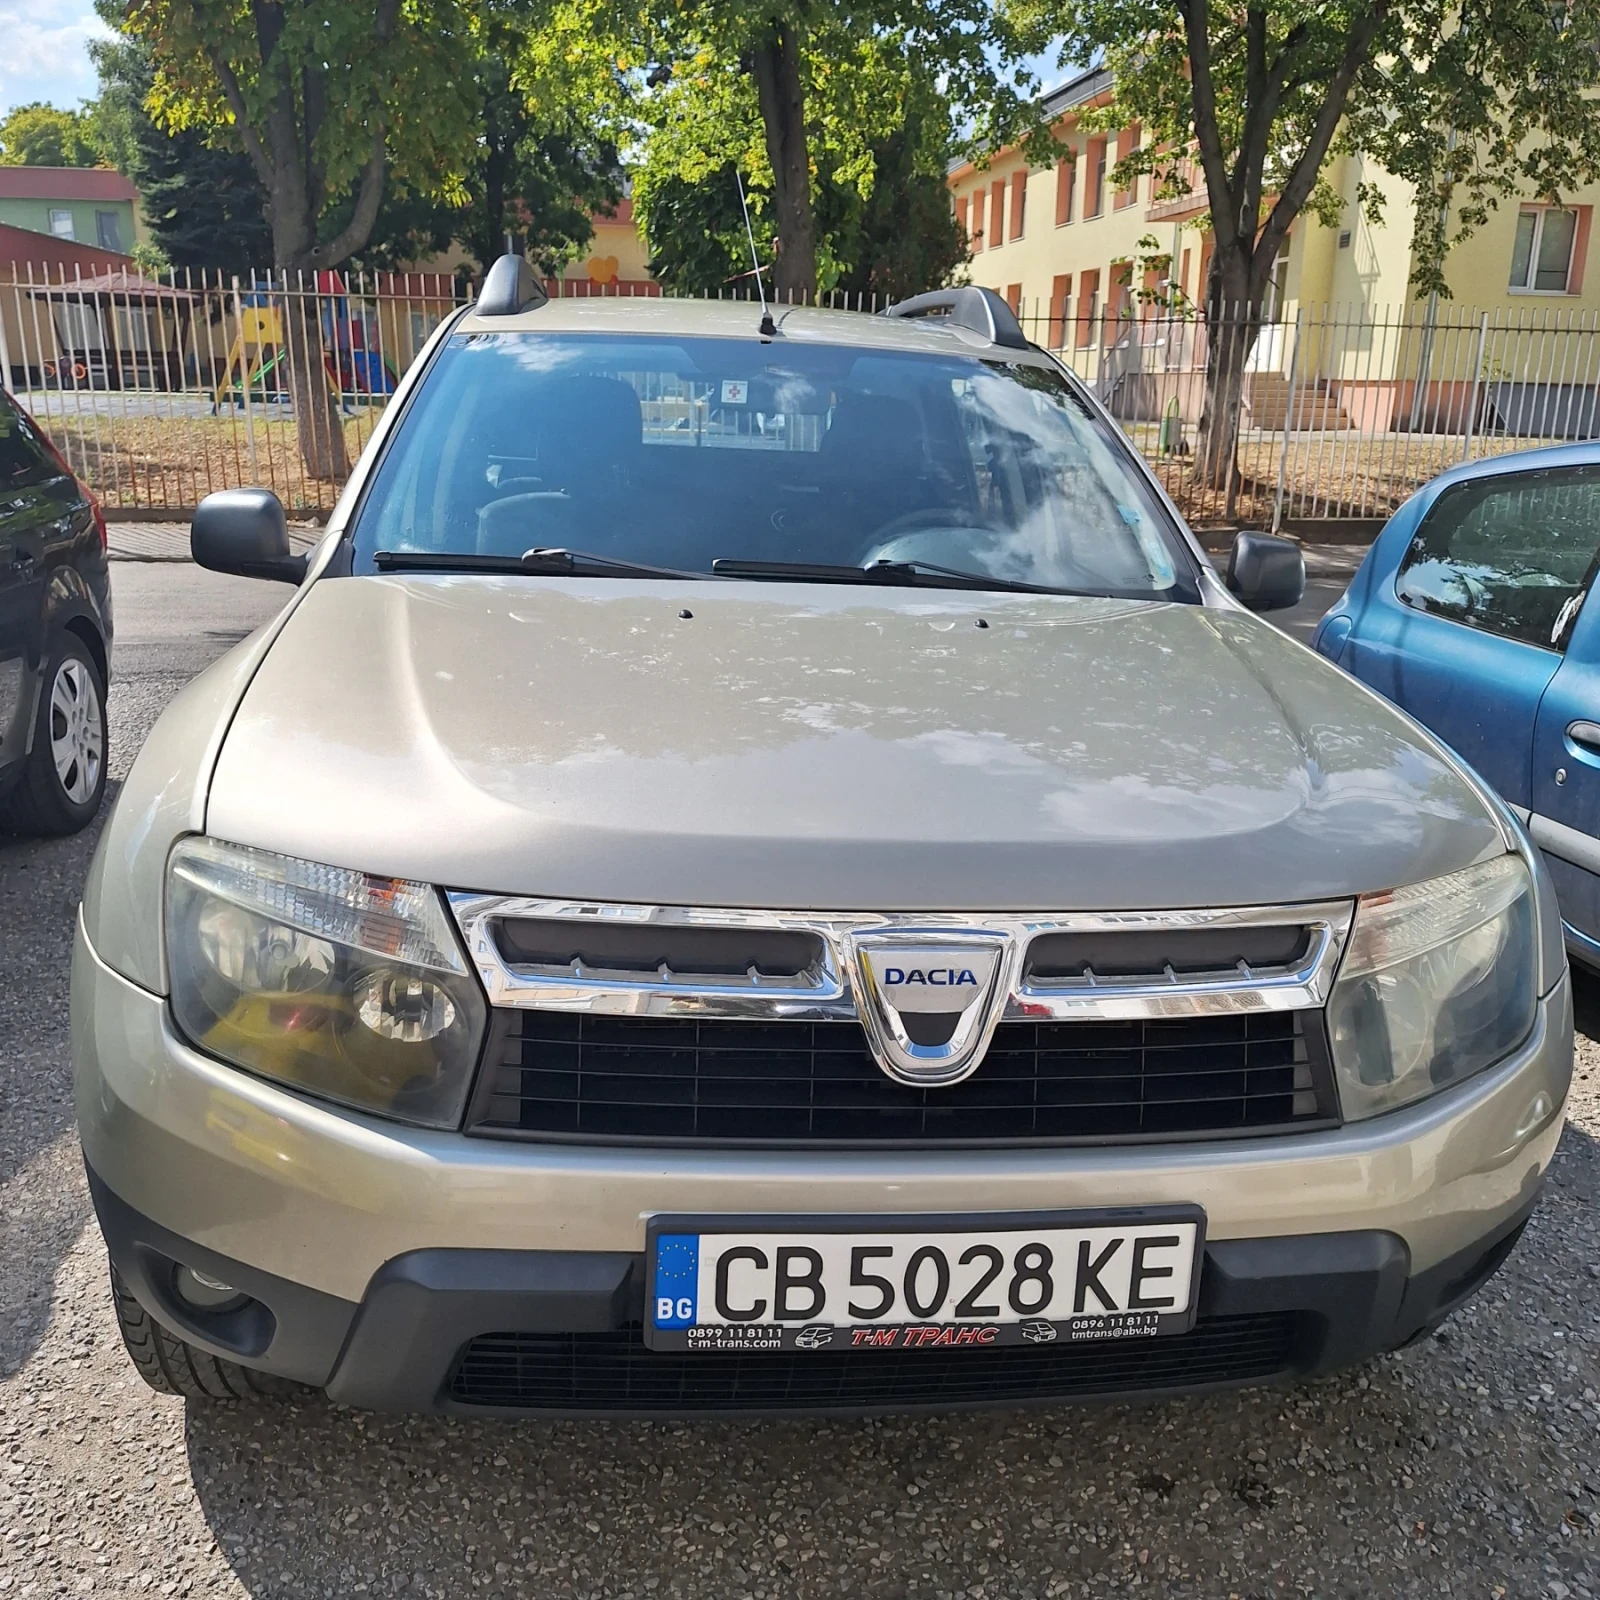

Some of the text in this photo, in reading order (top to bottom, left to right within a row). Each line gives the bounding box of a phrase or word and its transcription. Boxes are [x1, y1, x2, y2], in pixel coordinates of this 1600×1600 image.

[885, 968, 977, 986] DACIA
[715, 1235, 1180, 1321] CB 5028 KE
[657, 1297, 692, 1320] BG
[1071, 1325, 1158, 1339] tmtrans@abv.bg
[1072, 1319, 1105, 1330] 0896
[687, 1328, 723, 1338] 0899
[902, 1326, 1000, 1346] ТРАНС
[687, 1338, 781, 1348] t-m-trans.com
